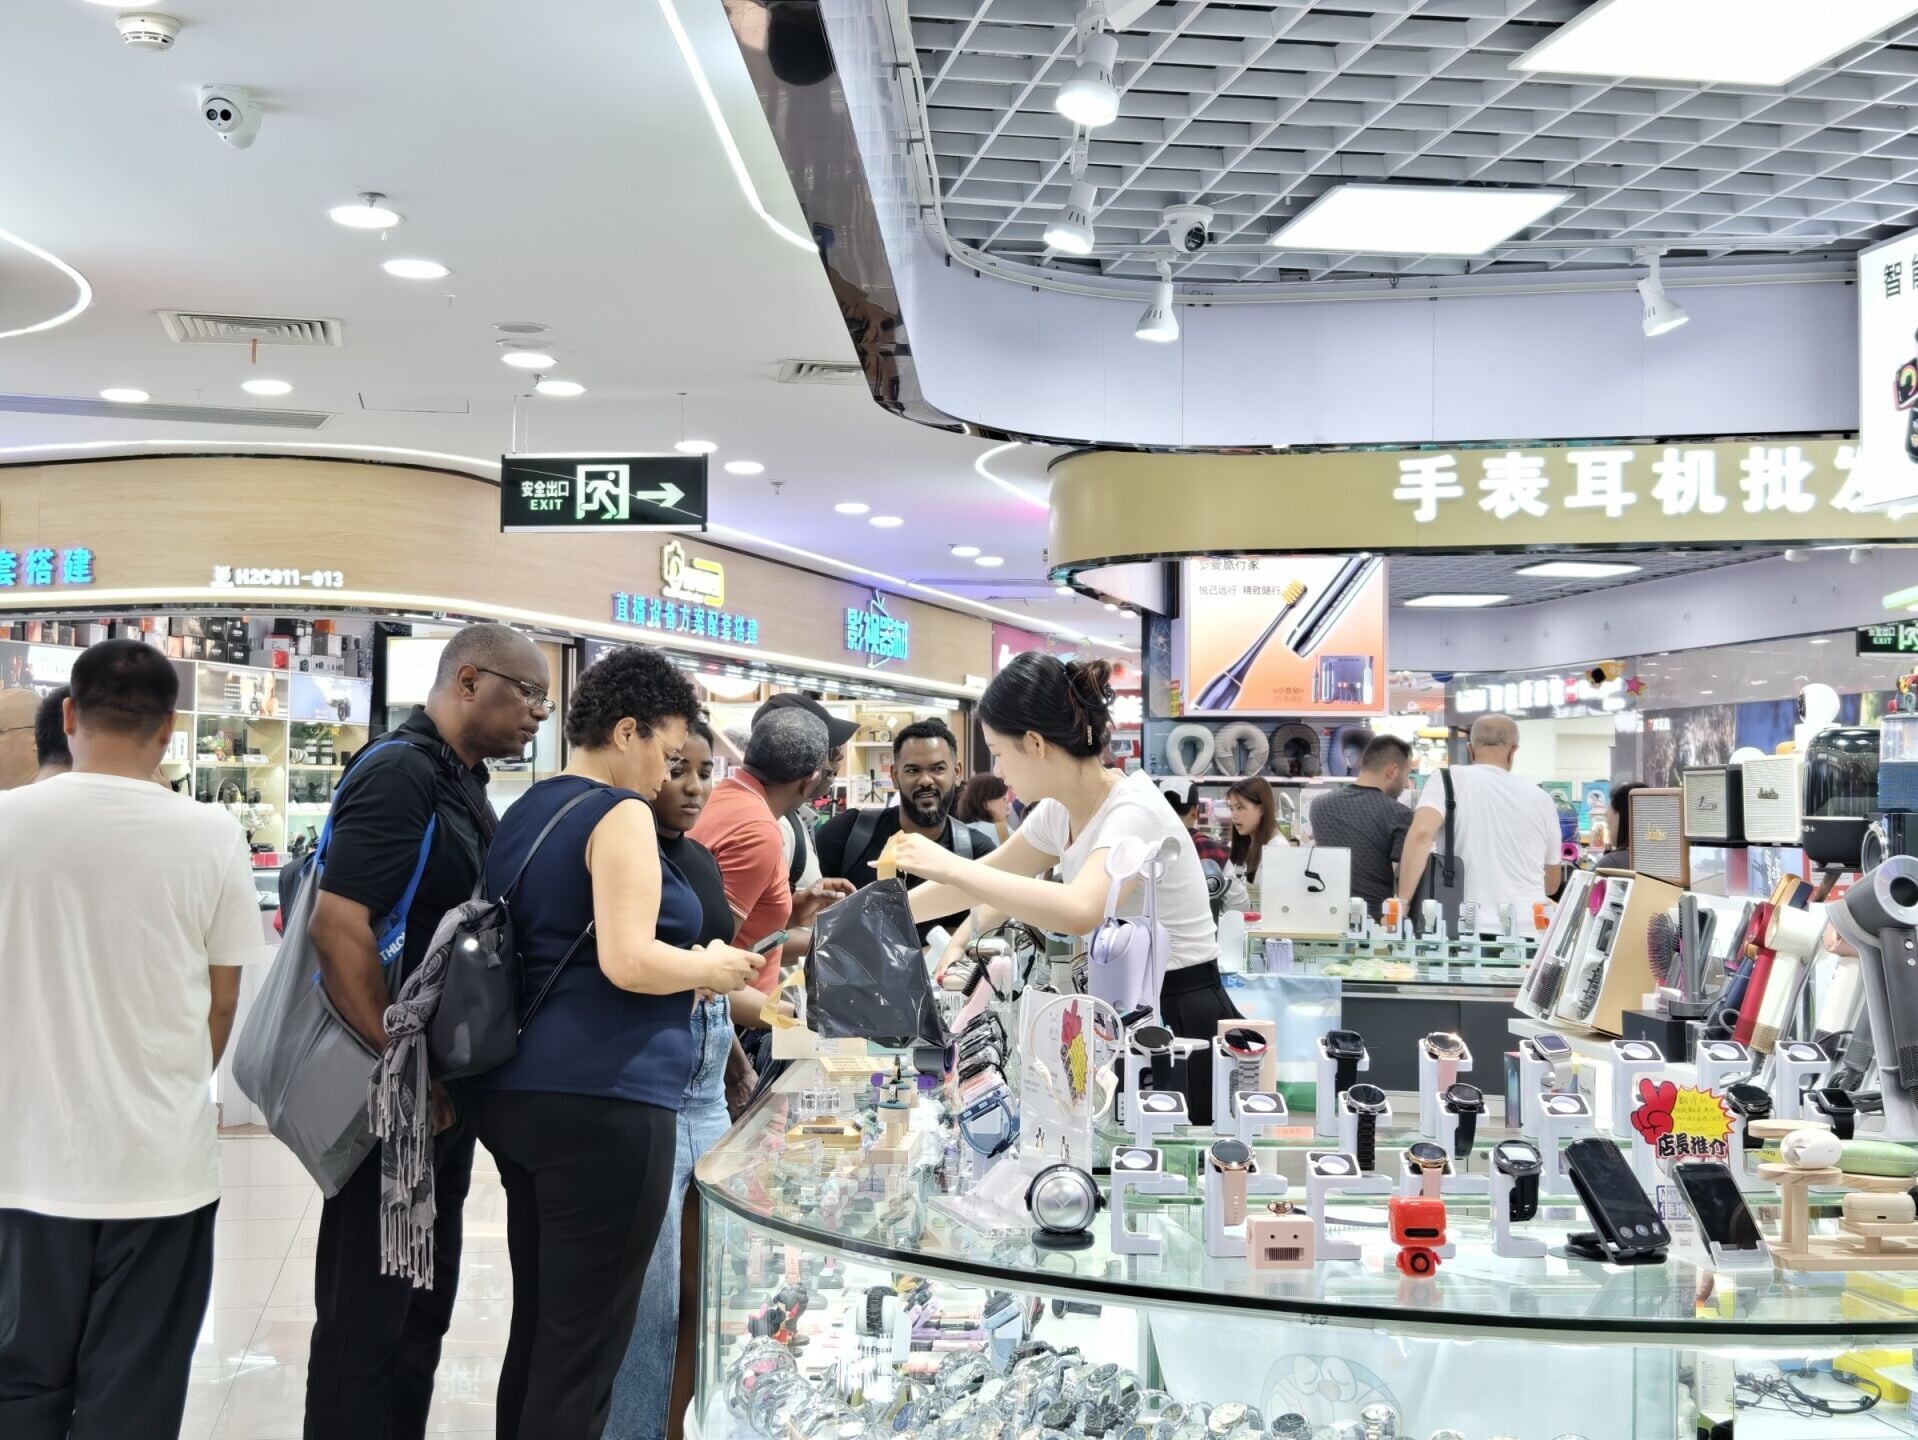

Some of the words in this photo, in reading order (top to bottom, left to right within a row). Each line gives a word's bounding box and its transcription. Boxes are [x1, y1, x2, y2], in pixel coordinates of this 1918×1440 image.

[521, 481, 569, 497] 安全出口
[530, 500, 563, 511] EXIT
[613, 591, 758, 645] 直播设备方案配套搭建
[846, 607, 909, 660] 影视器材
[1872, 636, 1892, 645] EXIT
[379, 932, 405, 960] THLO
[1657, 1132, 1727, 1157] 店長推介
